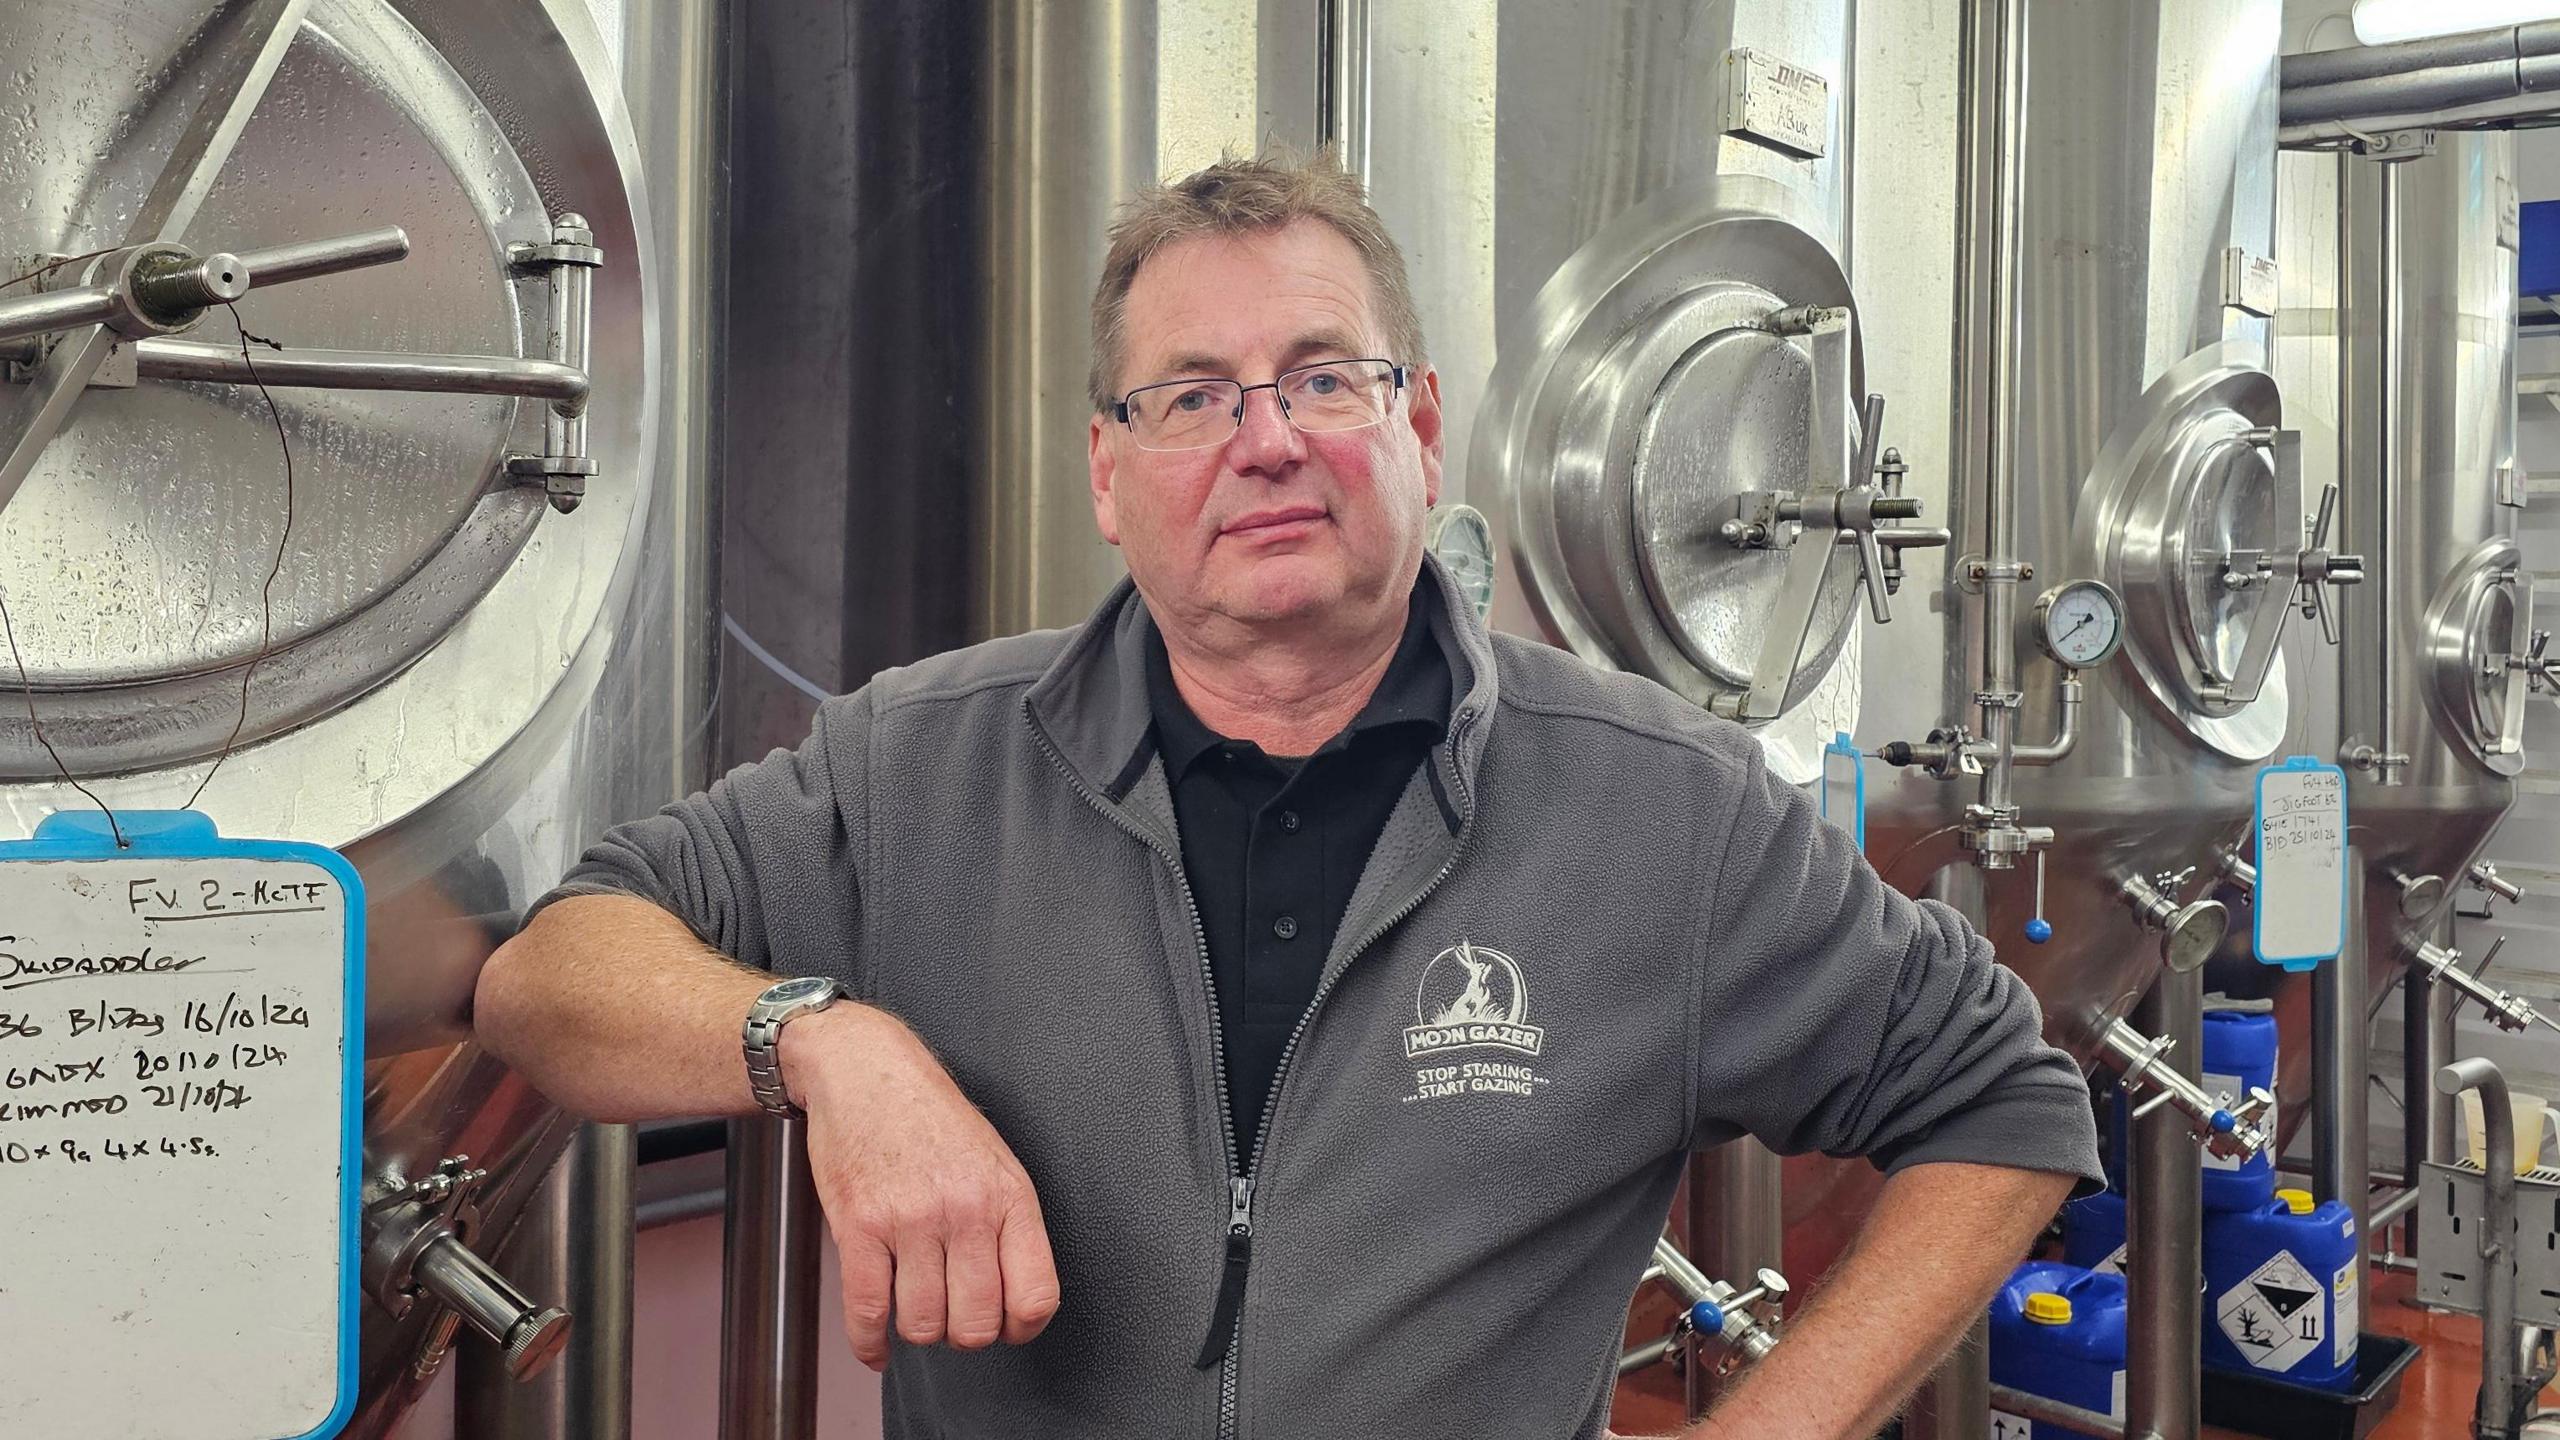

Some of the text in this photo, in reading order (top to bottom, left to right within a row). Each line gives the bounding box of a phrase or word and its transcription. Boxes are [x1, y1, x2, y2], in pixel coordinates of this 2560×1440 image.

[1410, 1025, 1537, 1050] MOON GAZER
[1417, 1062, 1550, 1085] STOP STARING...
[1402, 1077, 1533, 1103] ...START GAZING
